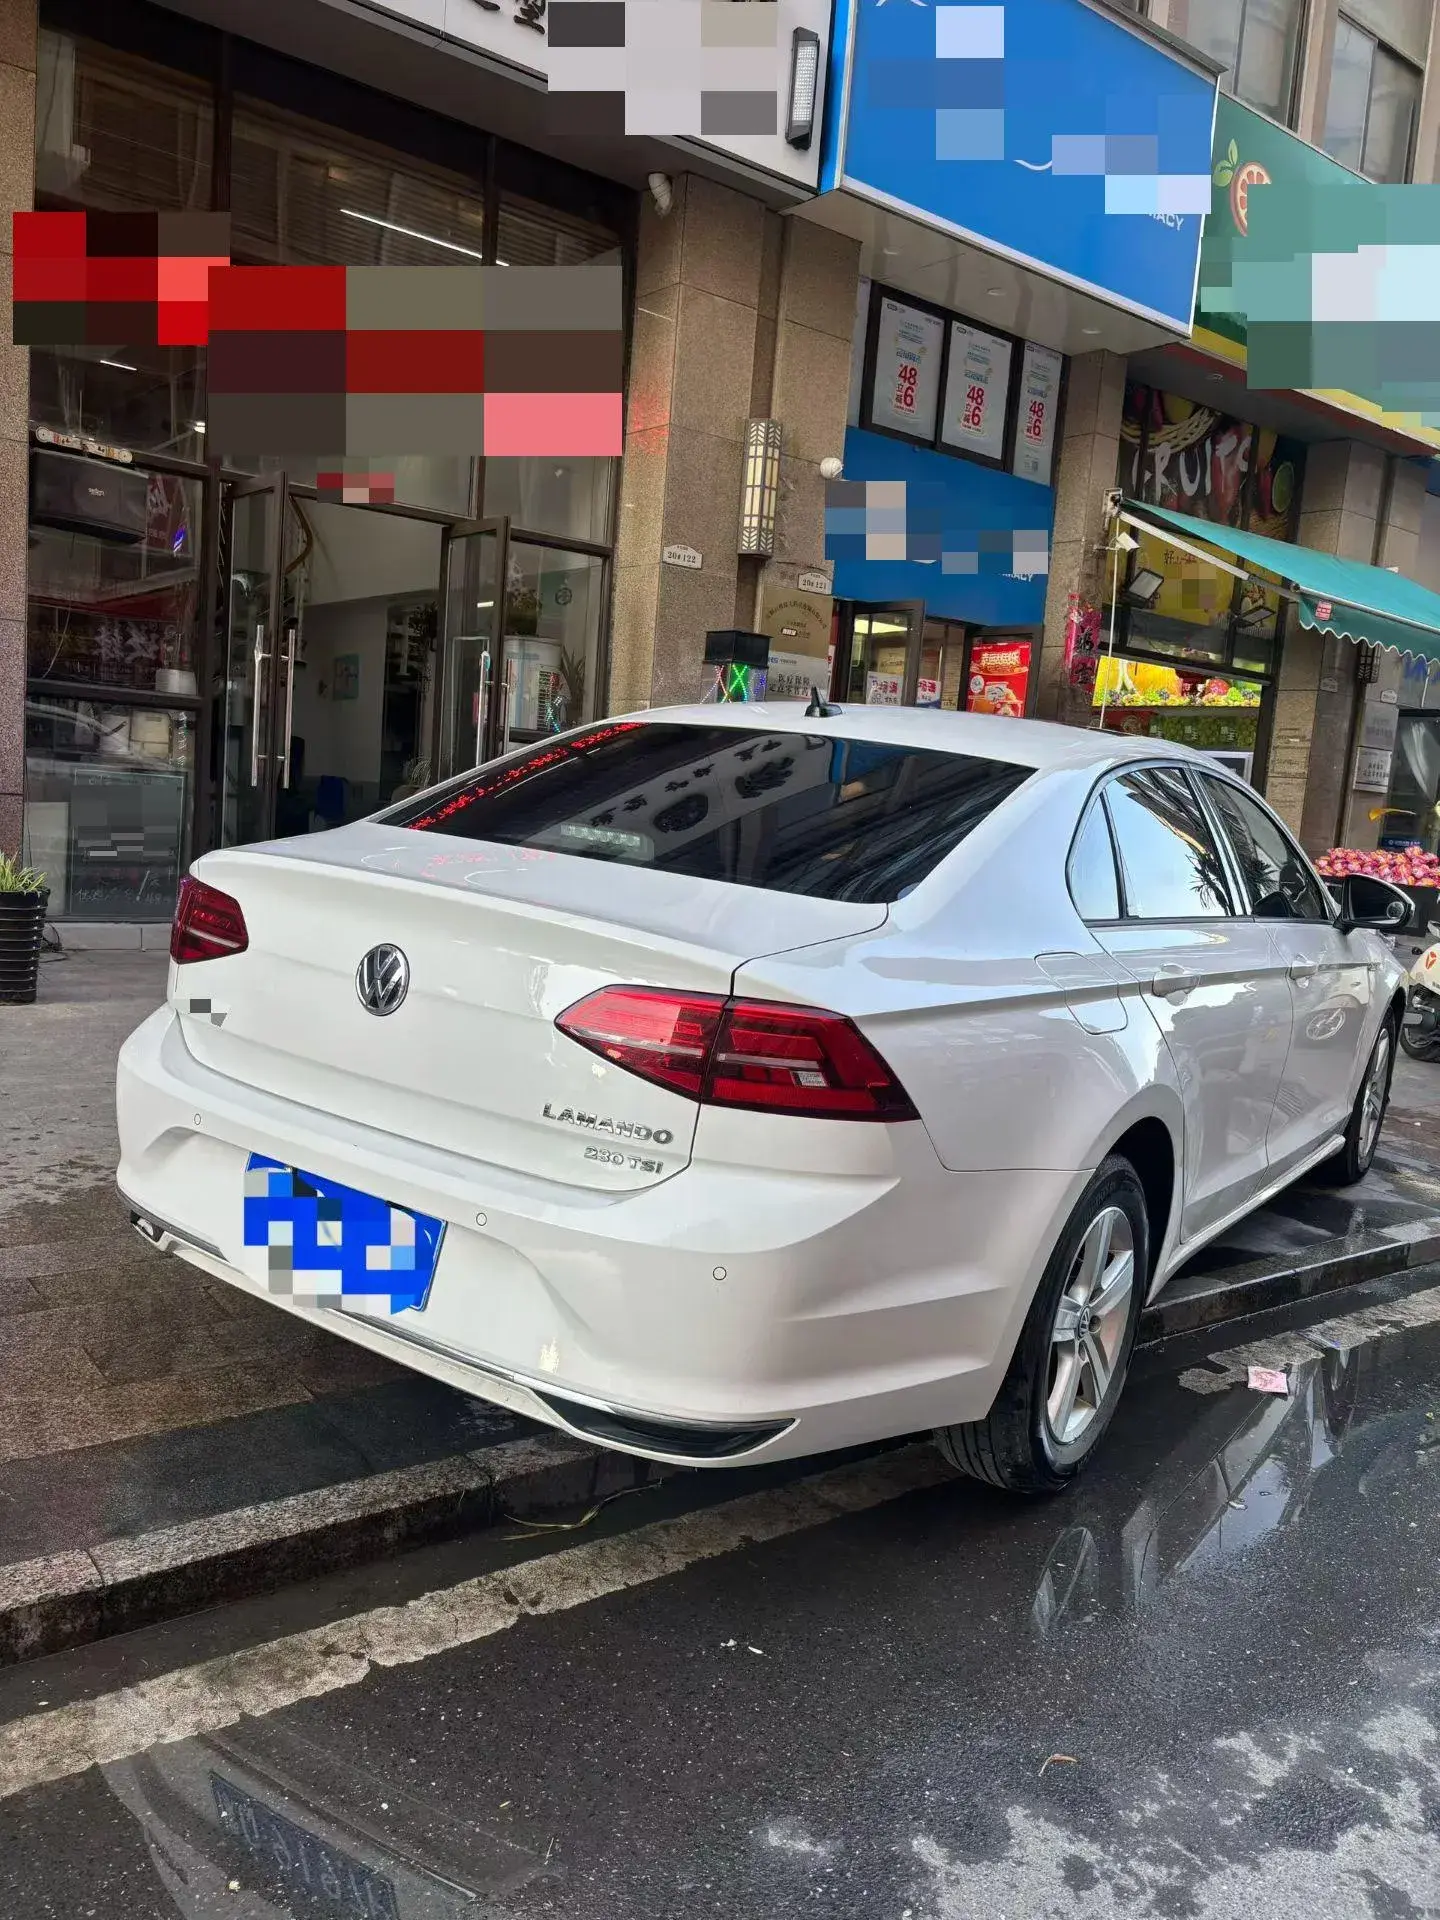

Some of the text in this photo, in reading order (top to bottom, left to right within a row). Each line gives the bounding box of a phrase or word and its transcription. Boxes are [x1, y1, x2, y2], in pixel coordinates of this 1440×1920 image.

[898, 364, 918, 386] 48
[903, 386, 915, 407] 6
[967, 385, 985, 406] 48
[971, 406, 982, 427] 6
[1029, 401, 1045, 418] 48
[1033, 419, 1042, 436] 6
[542, 1103, 674, 1145] LAMANDO
[584, 1146, 664, 1174] 230 TSI
